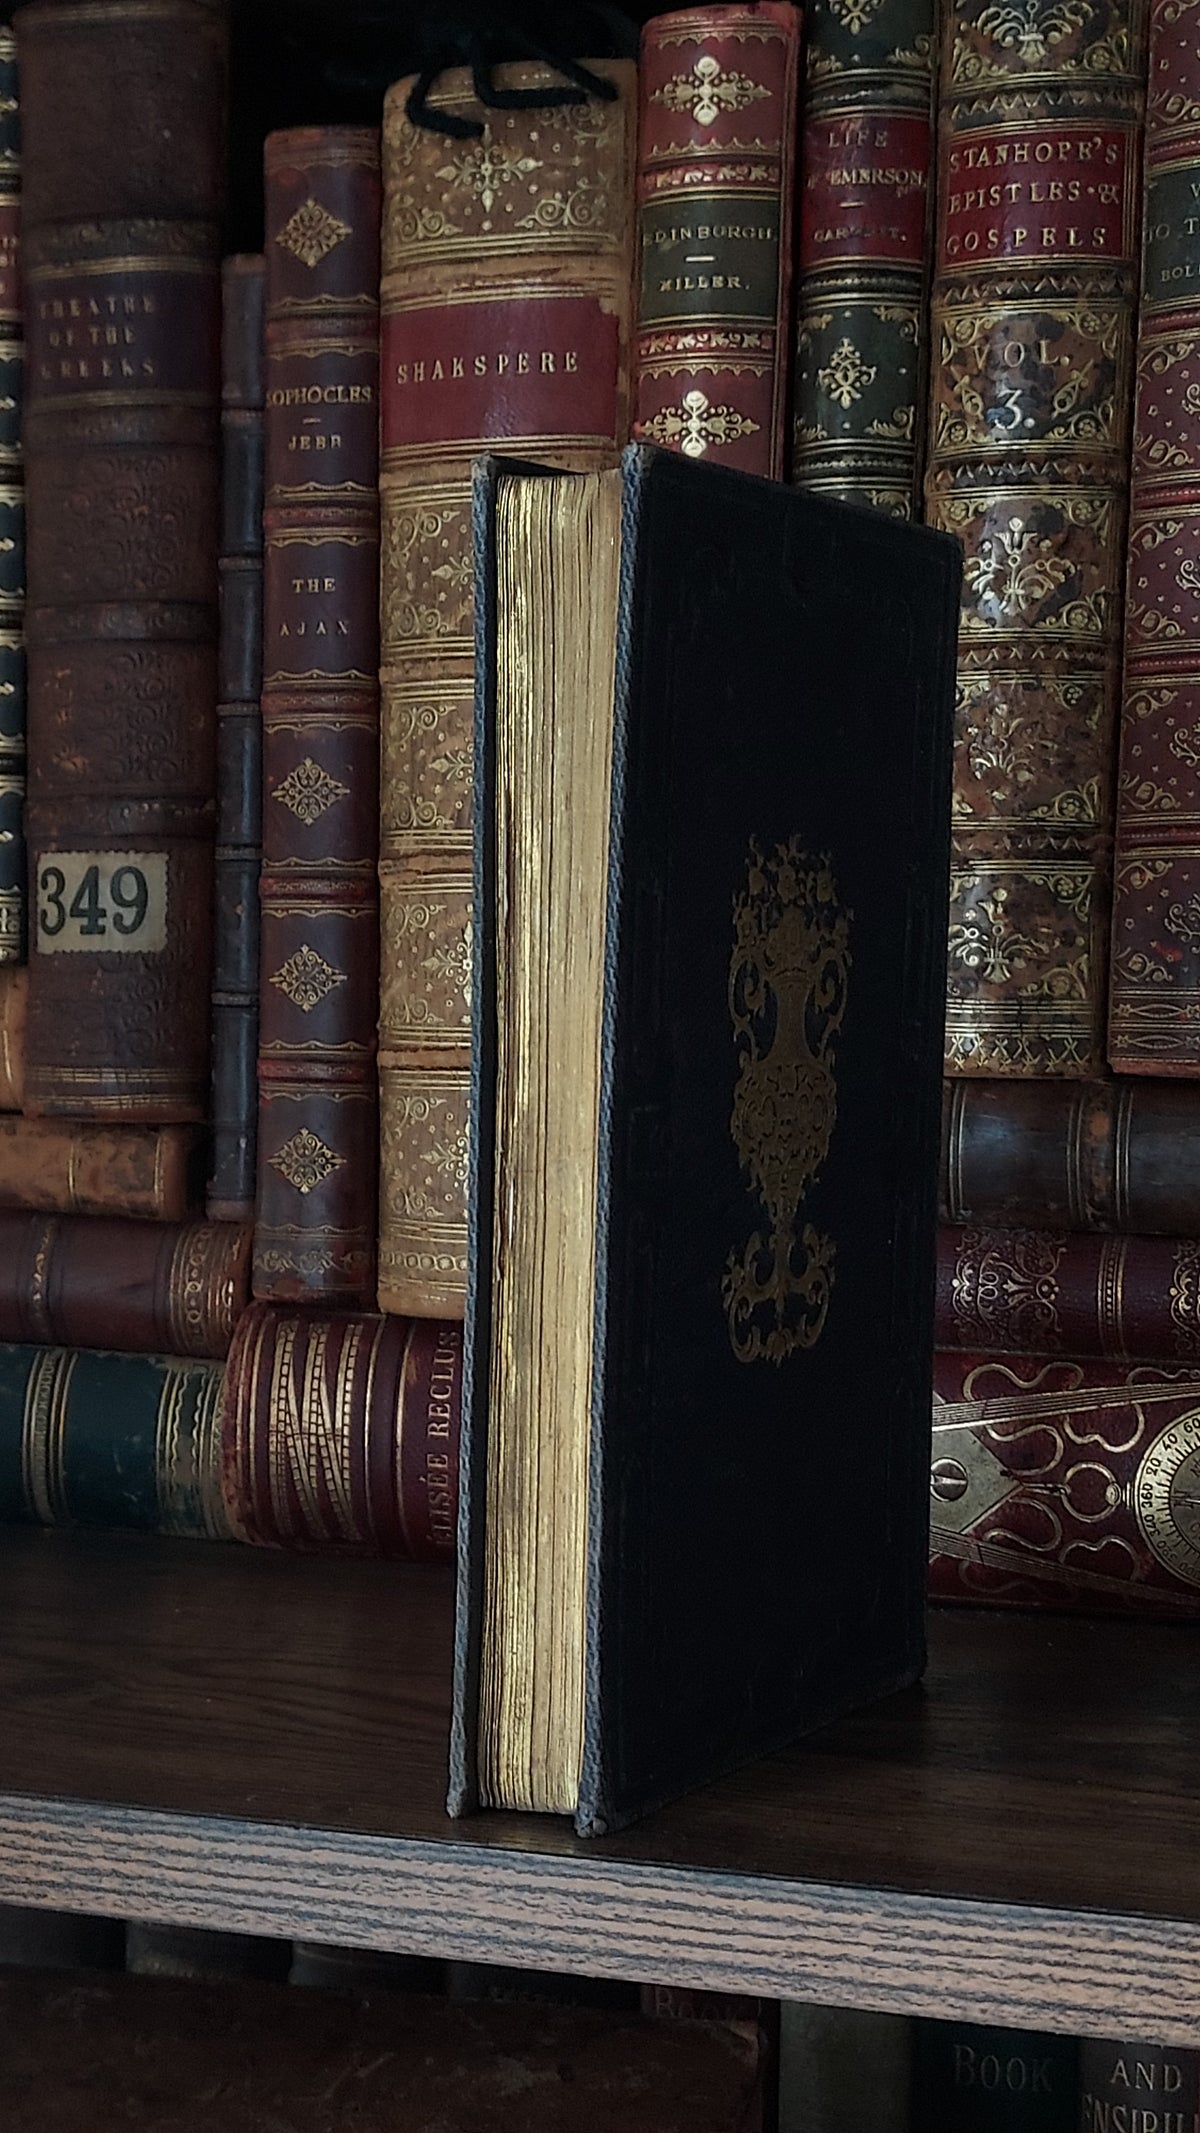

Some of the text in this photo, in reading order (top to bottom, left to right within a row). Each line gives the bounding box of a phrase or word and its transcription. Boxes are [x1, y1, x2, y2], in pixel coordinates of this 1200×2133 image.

[829, 131, 888, 148] LIFE
[949, 136, 1118, 173] STANHOPE'S
[946, 226, 1106, 255] GOSPELS
[971, 338, 1070, 370] VOL.
[396, 351, 578, 385] SHAKSPERE
[292, 578, 336, 594] THE
[280, 620, 349, 637] AJAX
[40, 865, 149, 936] 349
[427, 1330, 461, 1441] RECLUS
[1162, 1433, 1178, 1451] 40
[1146, 1457, 1162, 1477] 20
[1141, 1483, 1153, 1509] 360
[1144, 1513, 1161, 1537] 340
[1109, 2058, 1184, 2092] AND
